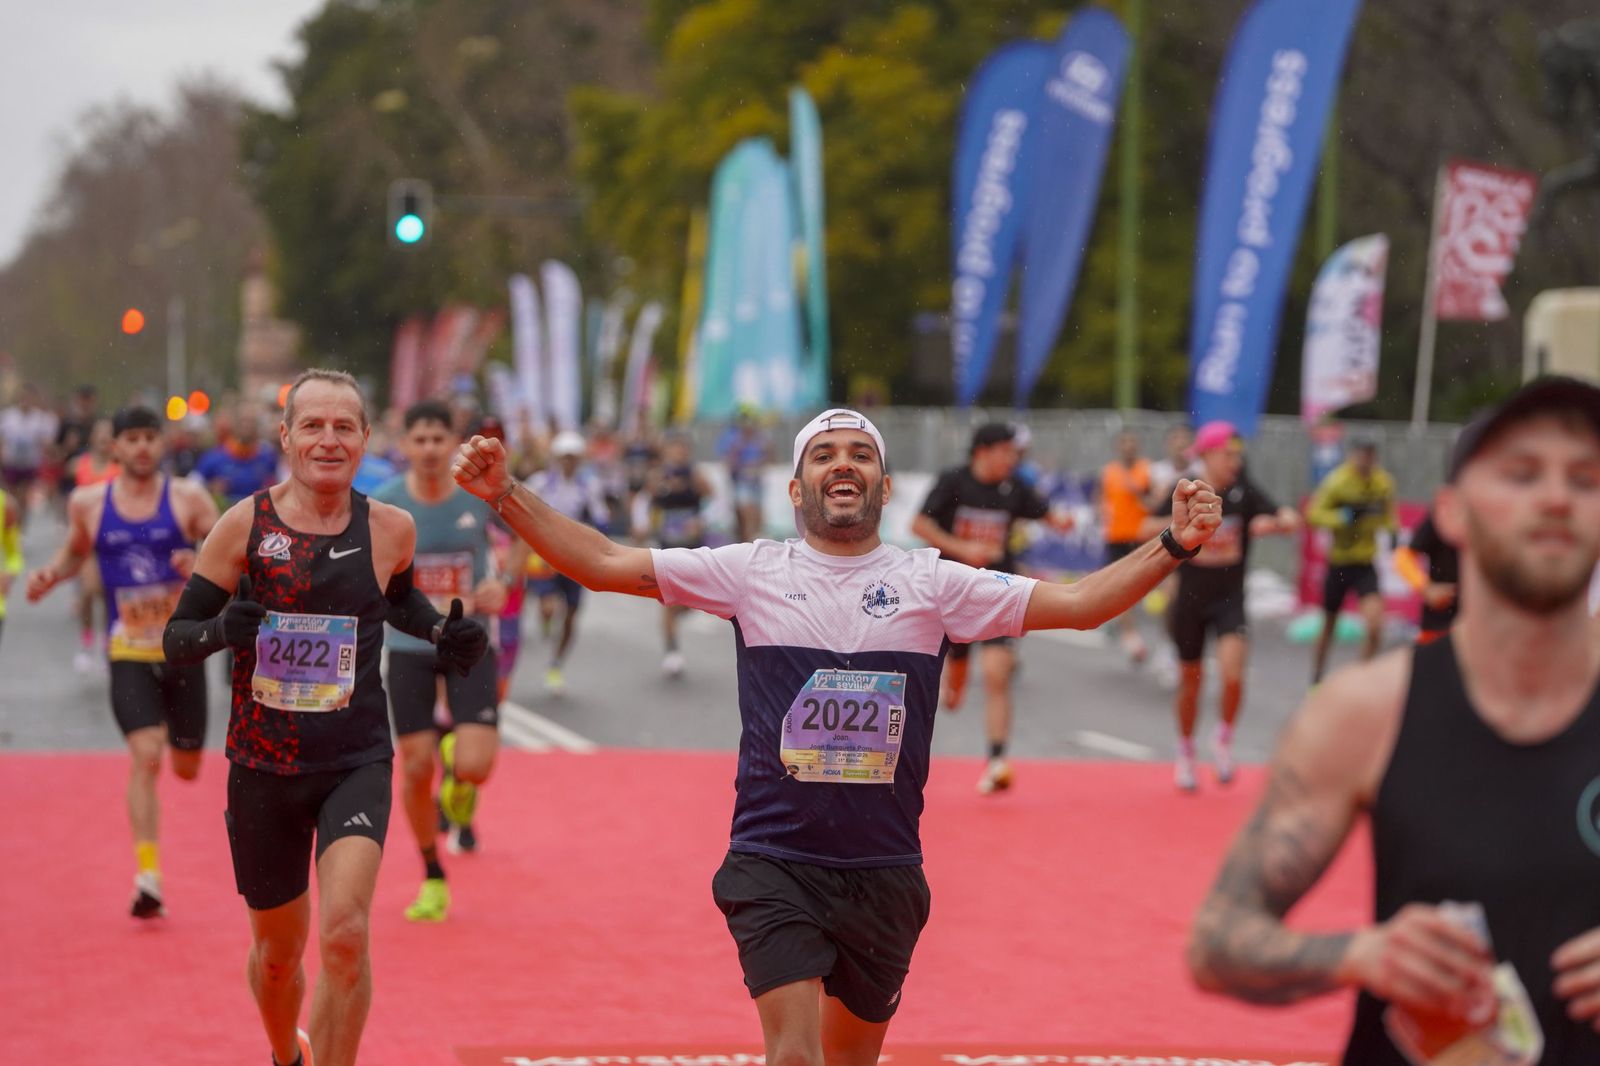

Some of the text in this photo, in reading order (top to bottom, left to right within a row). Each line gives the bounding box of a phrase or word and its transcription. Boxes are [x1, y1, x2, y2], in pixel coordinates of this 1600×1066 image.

[1195, 49, 1307, 394] Run to progress
[785, 593, 806, 601] TACTIC
[862, 590, 886, 601] PALMA
[867, 597, 900, 608] RUNNERS
[269, 636, 330, 668] 2422
[836, 680, 870, 690] sevilla
[801, 698, 879, 732] 2022
